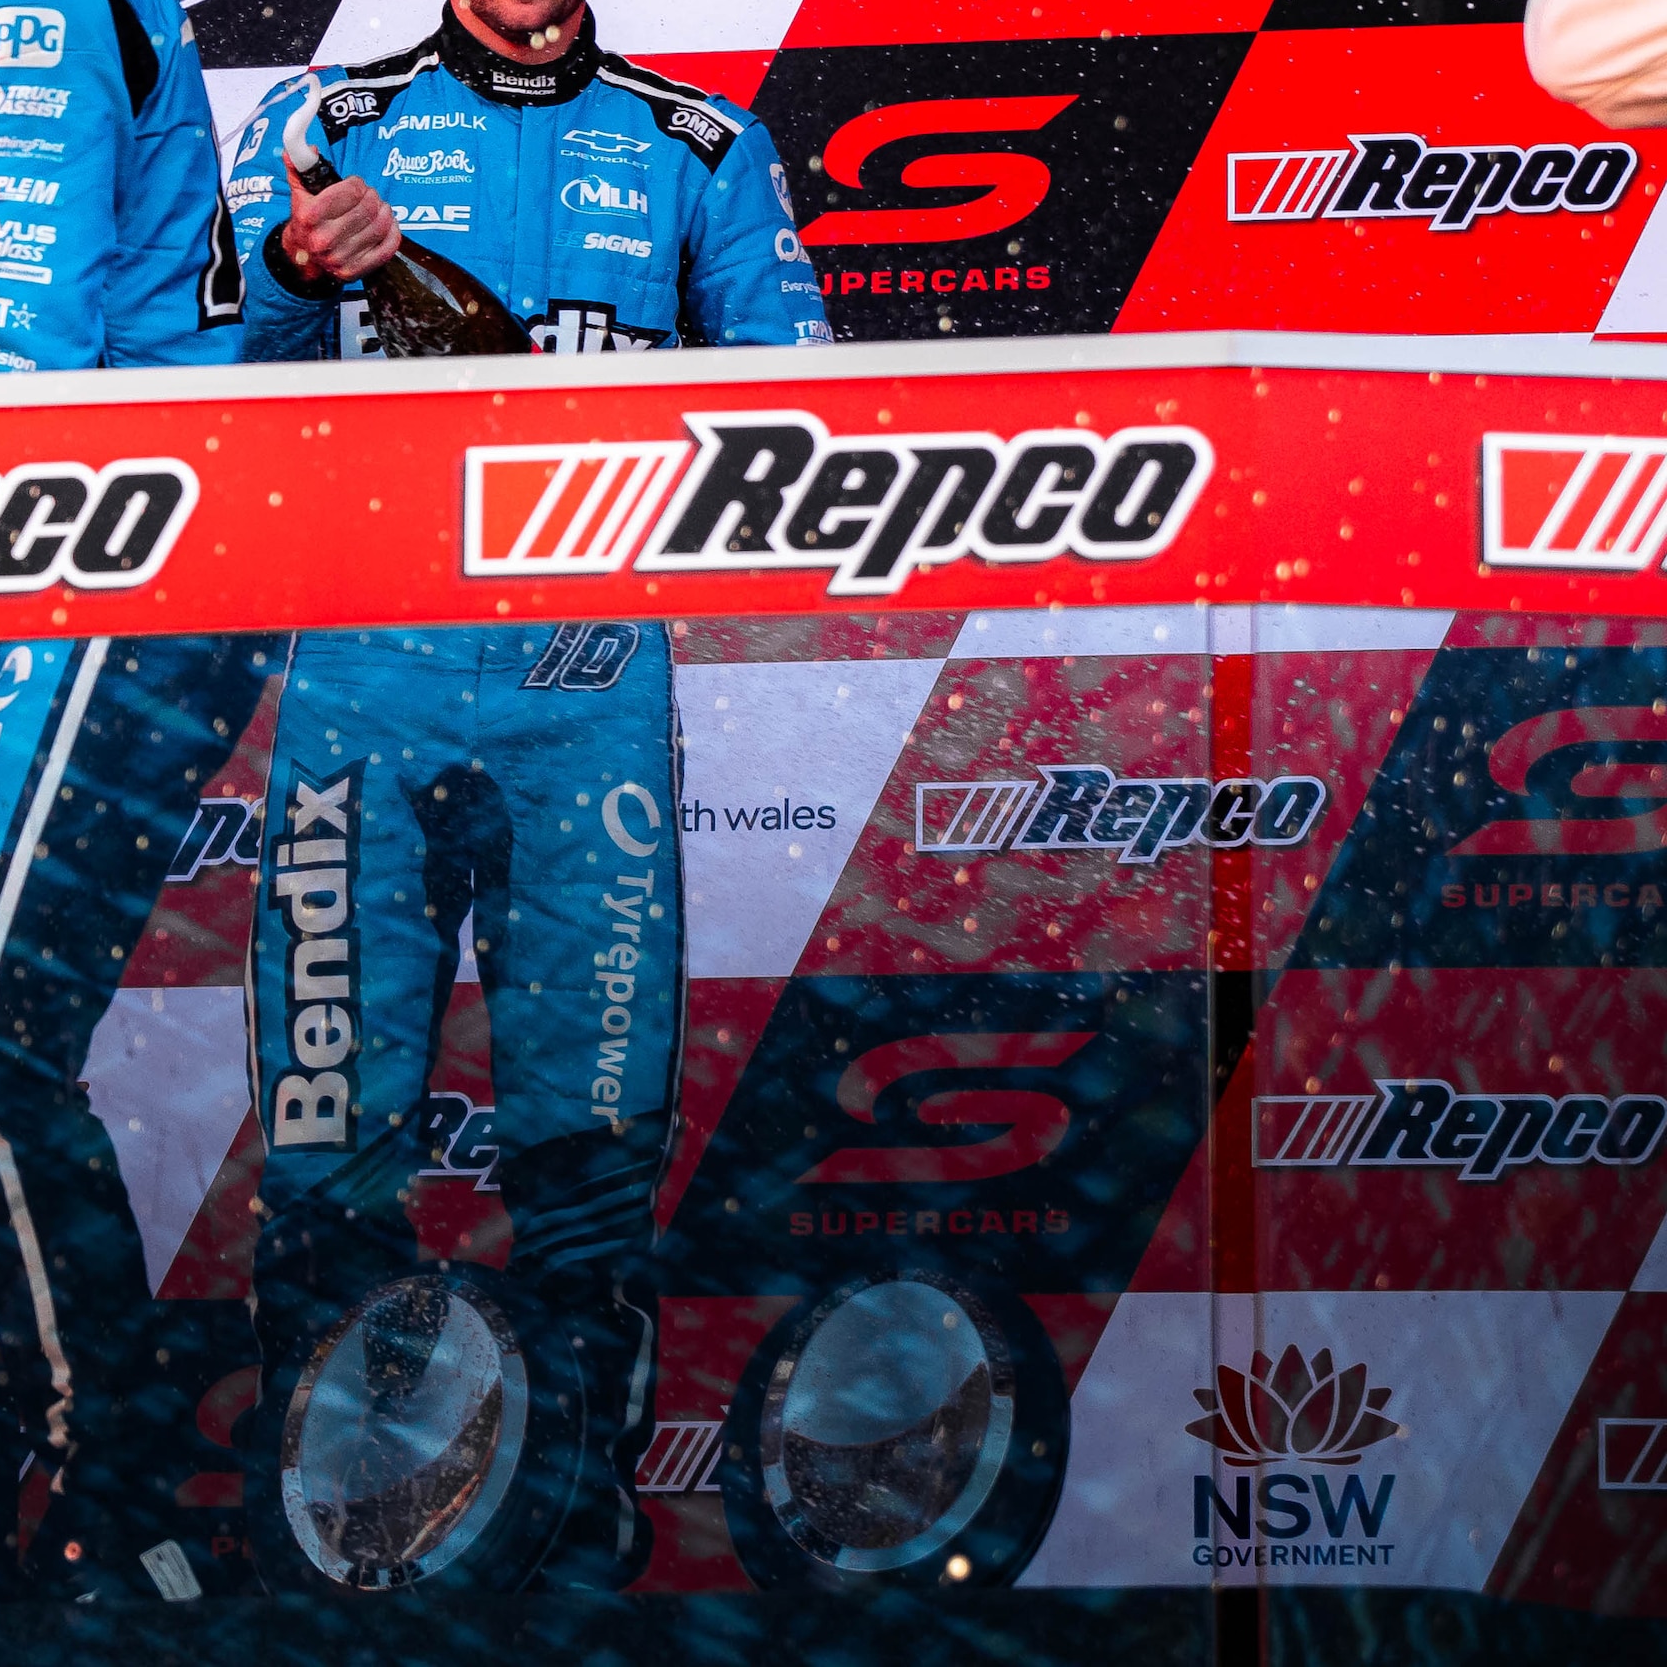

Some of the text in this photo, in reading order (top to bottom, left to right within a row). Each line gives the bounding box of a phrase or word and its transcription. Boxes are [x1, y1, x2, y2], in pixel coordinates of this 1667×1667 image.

[5, 85, 73, 104] TRUCK
[492, 70, 557, 89] Bendix
[329, 95, 378, 118] OMP
[670, 110, 721, 144] OMP
[381, 147, 476, 177] Bruce Rock
[559, 149, 651, 172] CHEVROLET
[227, 175, 275, 196] RUCK
[403, 174, 473, 185] ENGINEERING
[1322, 131, 1639, 232] Repco
[227, 192, 274, 215] SSIST
[578, 181, 649, 215] MLH
[390, 205, 472, 223] DAF
[821, 265, 1053, 297] PERCARS
[635, 410, 1215, 597] Repco
[723, 795, 837, 833] wales
[1010, 763, 1328, 866] Repco
[1441, 881, 1667, 910] SUPERCA
[273, 774, 352, 1148] Bendix
[590, 867, 655, 1128] Tyrepower
[1350, 1078, 1667, 1182] Repco
[789, 1210, 1070, 1239] SUPERCARS
[1193, 1473, 1397, 1540] NSW
[1192, 1543, 1396, 1569] GOVERNMENT
